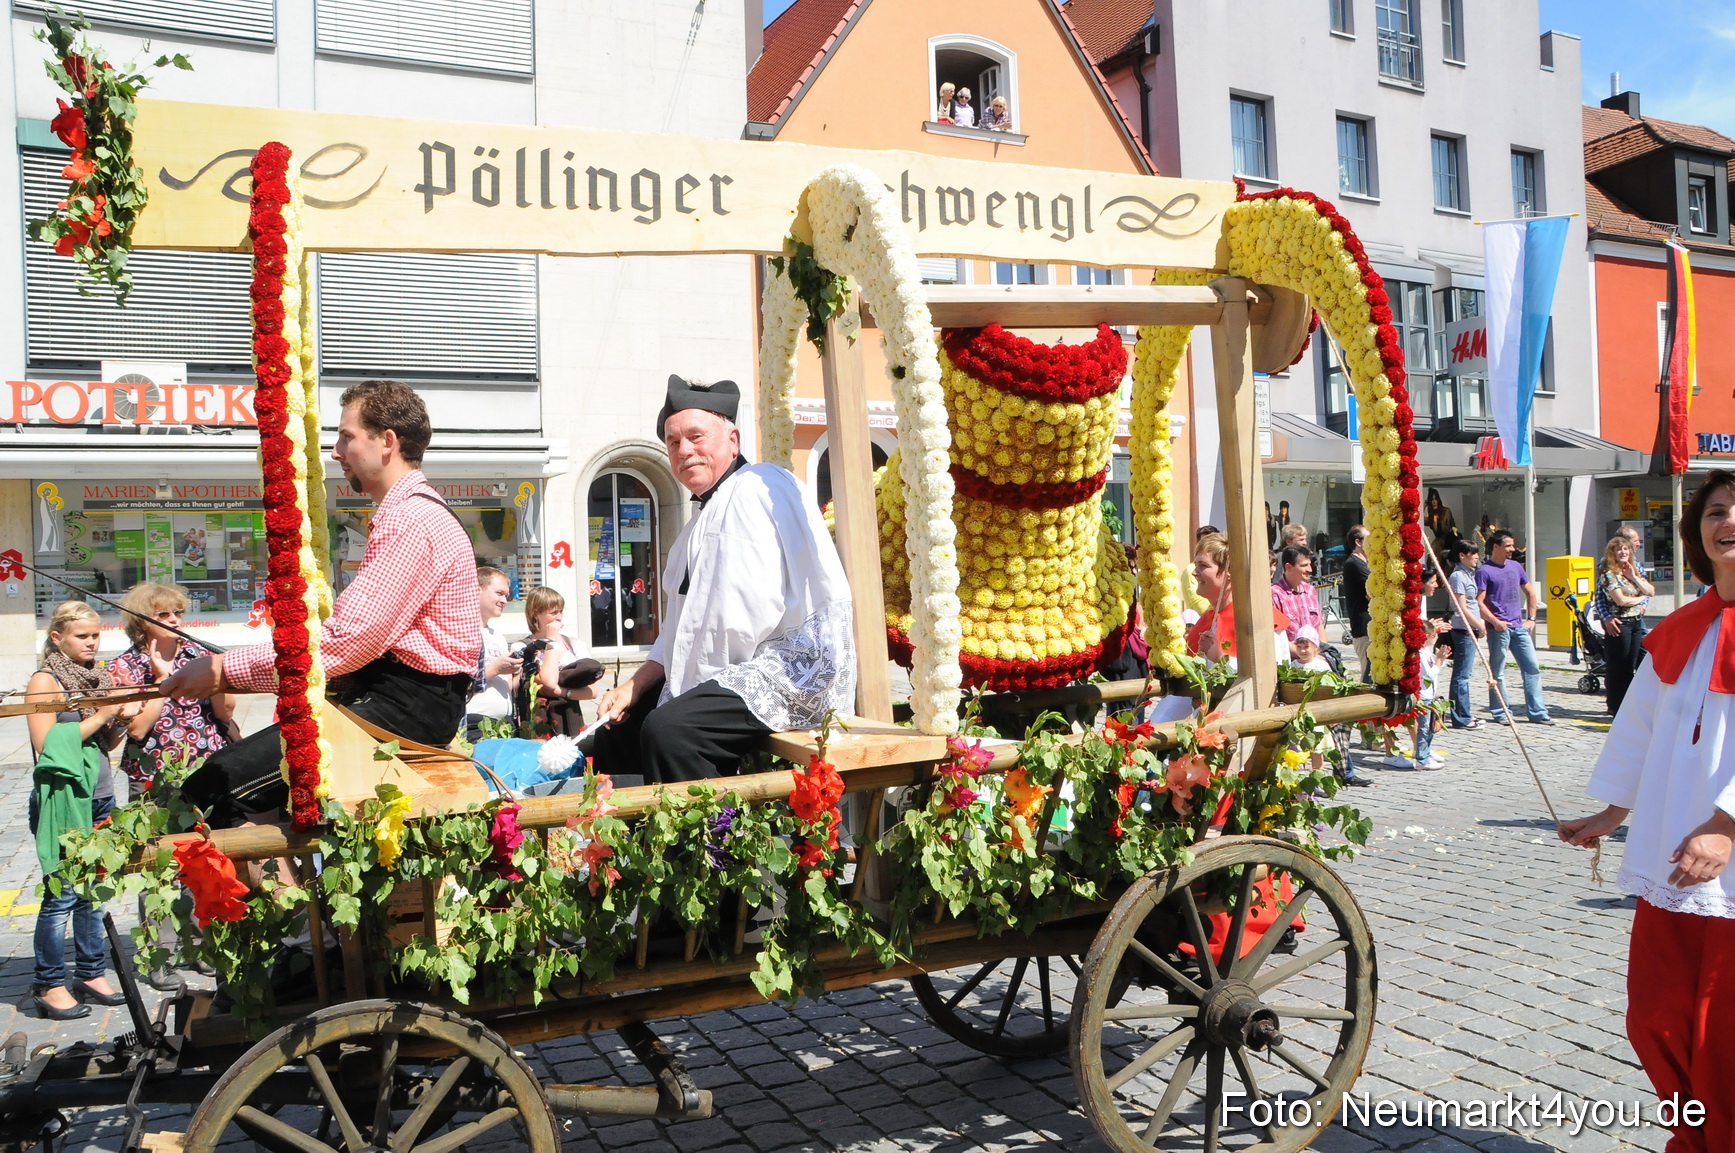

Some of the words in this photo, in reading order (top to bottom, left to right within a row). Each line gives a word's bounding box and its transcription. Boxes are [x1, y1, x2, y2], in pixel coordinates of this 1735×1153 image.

[414, 140, 735, 225] Pöllinger
[884, 168, 1095, 243] hwengl
[1451, 327, 1487, 364] H&M
[172, 485, 262, 498] APOTHEK
[130, 501, 163, 509] möchten,
[226, 501, 244, 509] geht!
